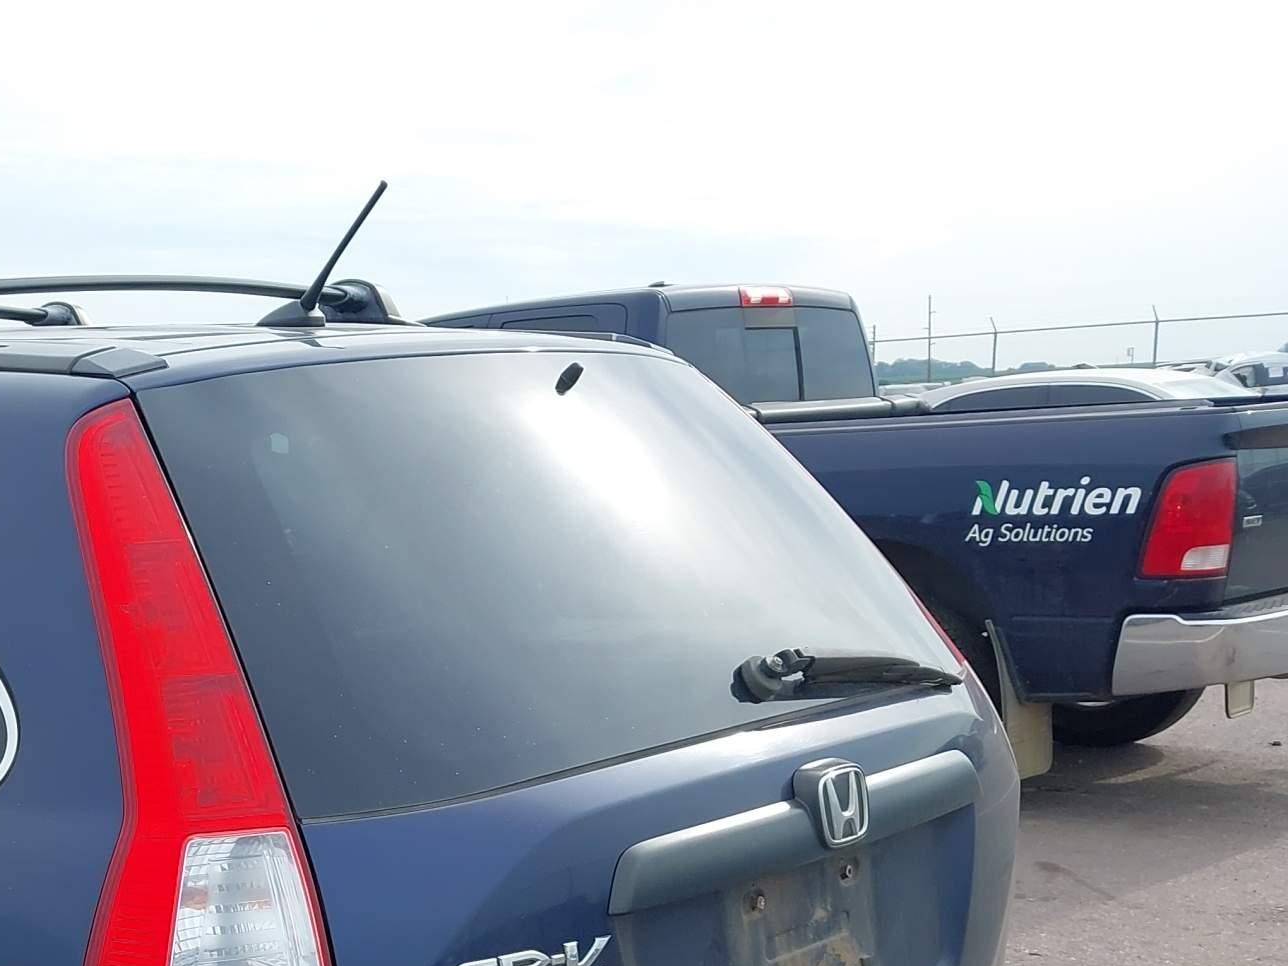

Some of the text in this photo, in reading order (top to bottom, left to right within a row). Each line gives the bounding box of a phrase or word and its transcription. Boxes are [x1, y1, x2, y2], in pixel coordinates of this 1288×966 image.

[971, 476, 1142, 516] Nutrien
[965, 523, 1093, 547] Ag Solutions
